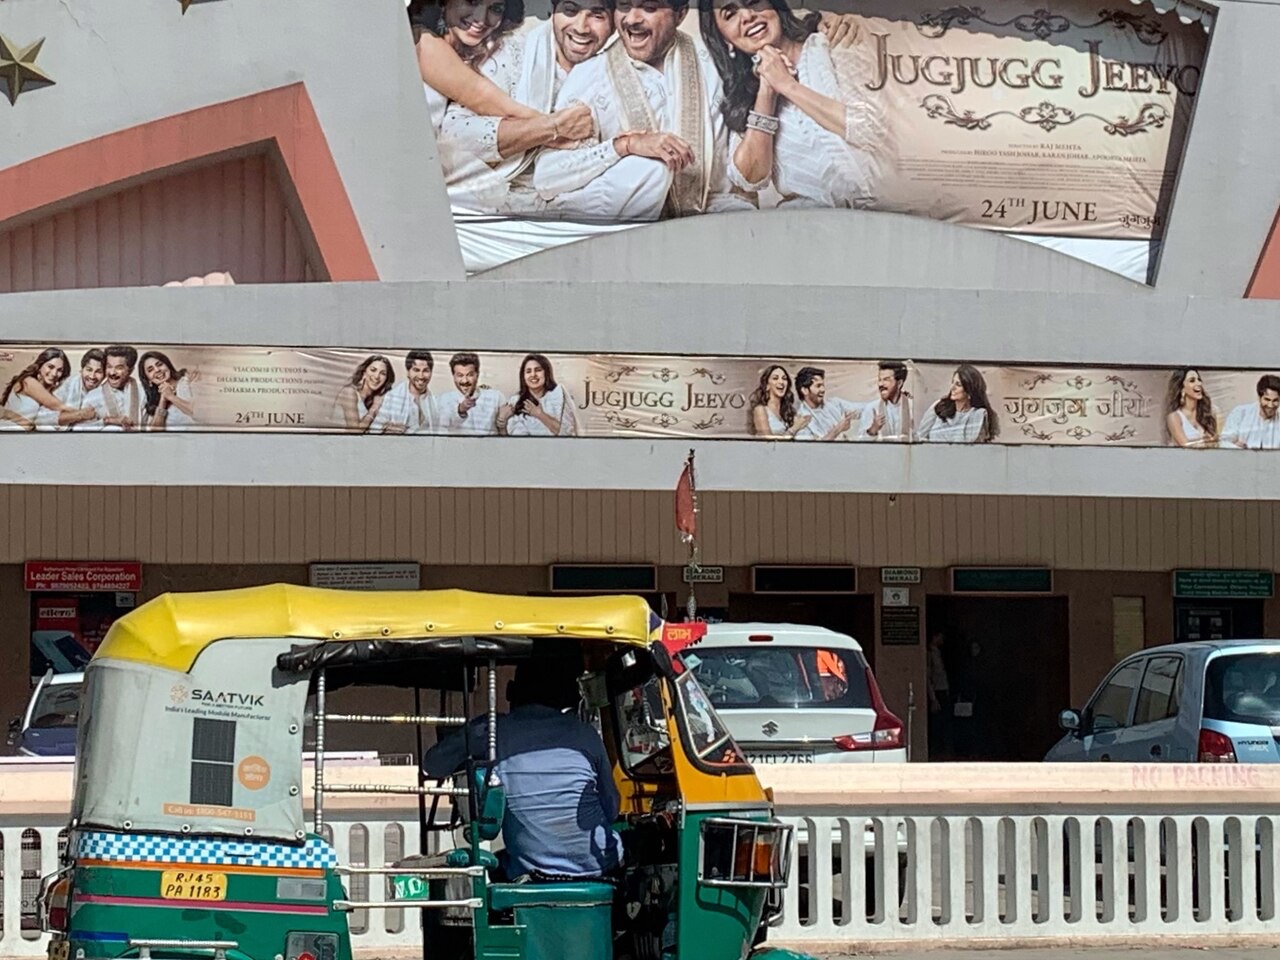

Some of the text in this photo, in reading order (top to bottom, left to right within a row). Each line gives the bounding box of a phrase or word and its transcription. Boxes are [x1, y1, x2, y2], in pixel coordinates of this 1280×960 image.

[865, 33, 1201, 98] JUGJUGG JEEYO
[981, 197, 1098, 225] 24TH JUNE
[579, 380, 746, 411] JUGJUGG JEEYO
[235, 411, 305, 427] 24TH JUNE
[30, 571, 136, 583] Leader Sales Corporation
[191, 689, 265, 707] SAATVIK
[165, 884, 221, 899] PA 1183
